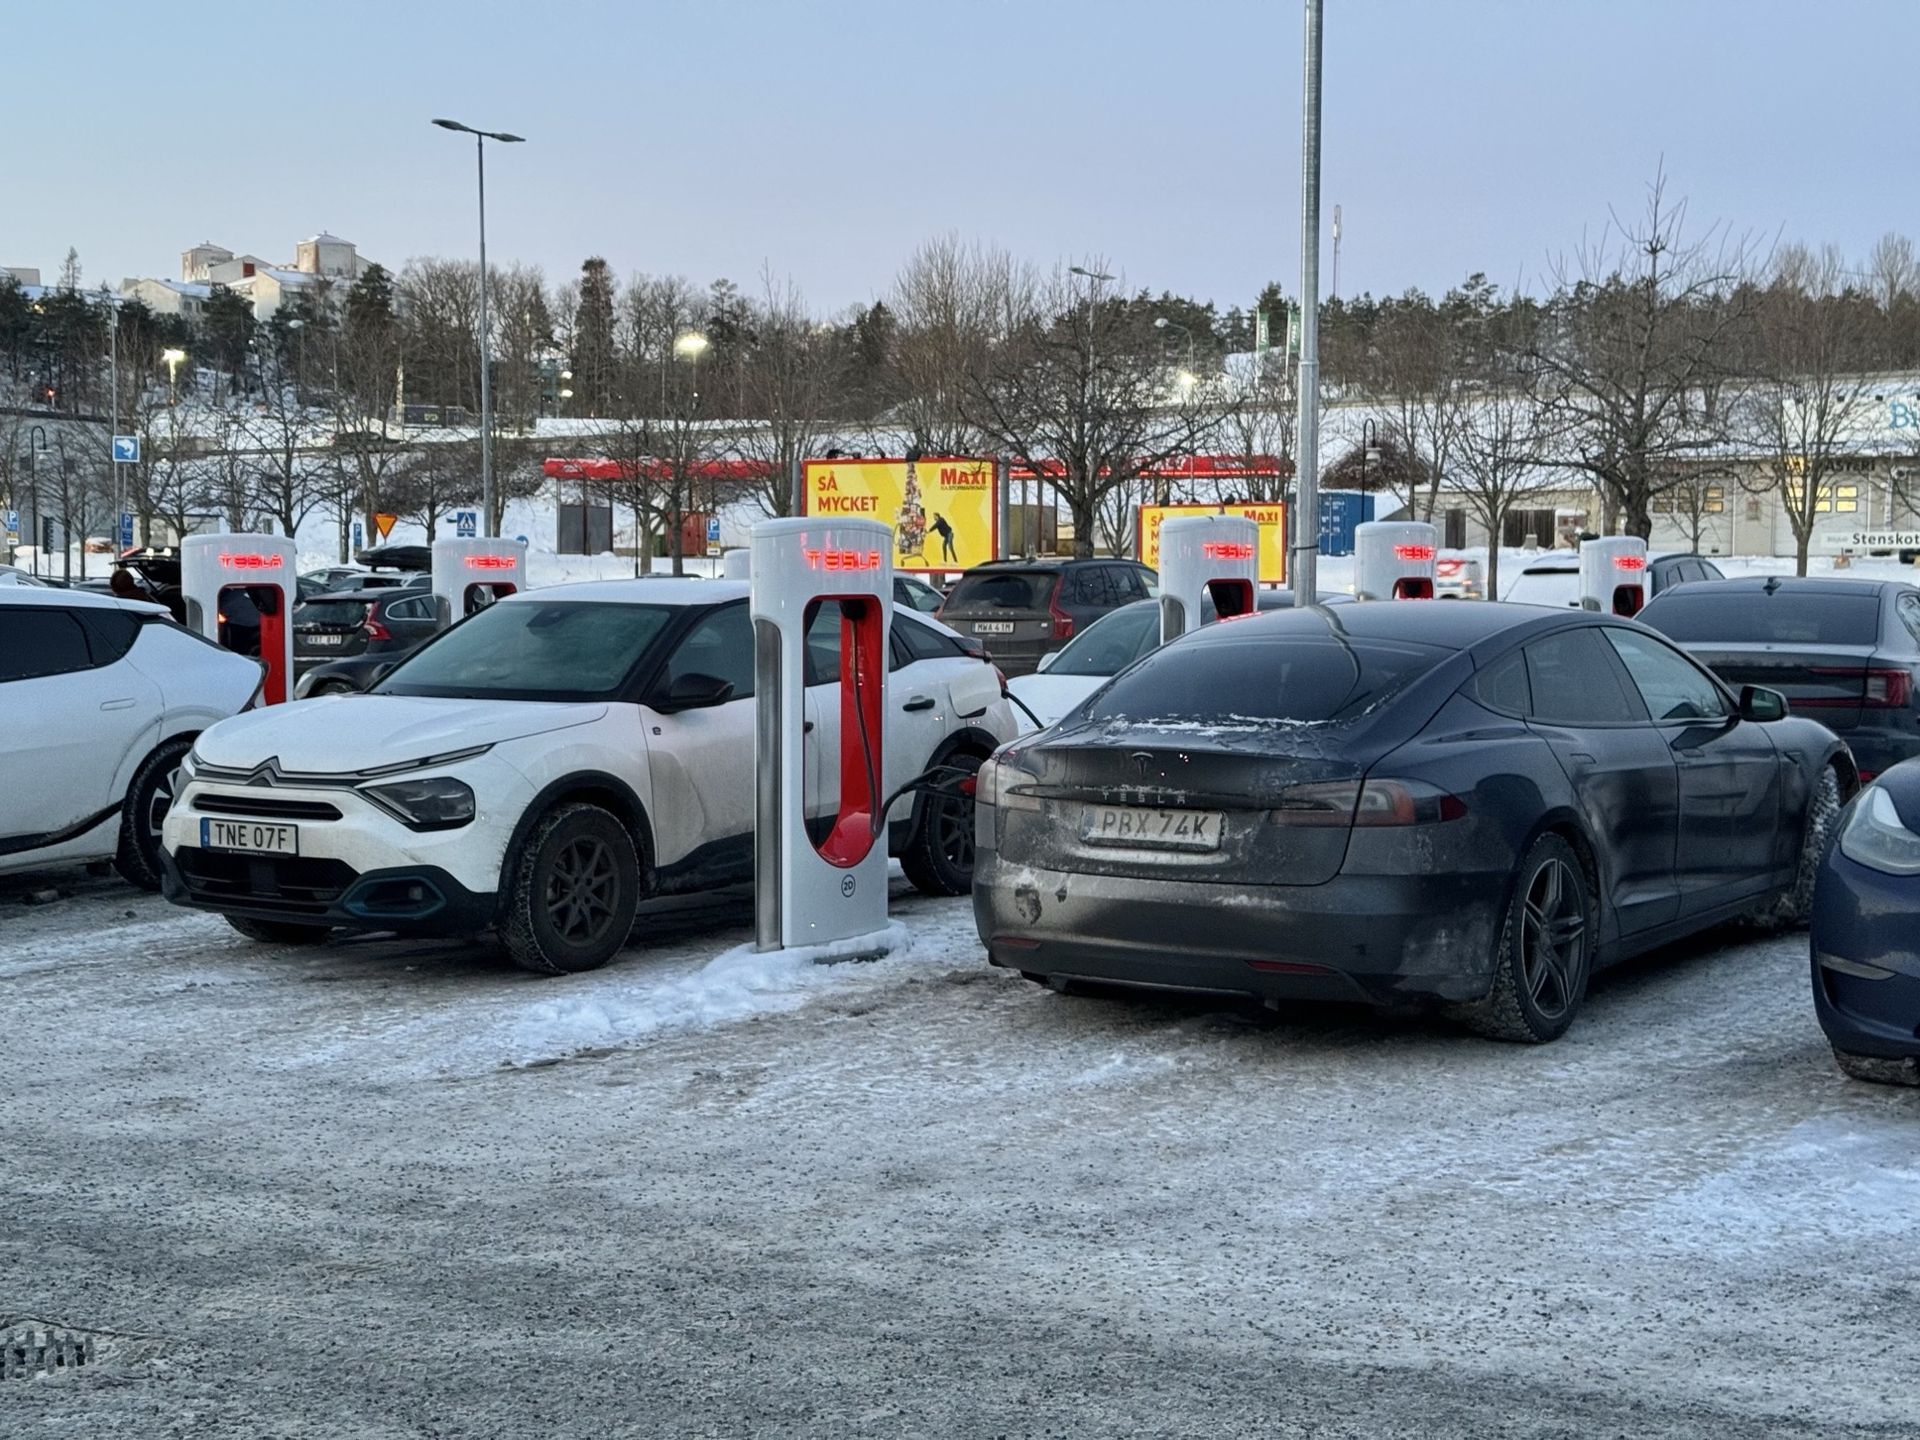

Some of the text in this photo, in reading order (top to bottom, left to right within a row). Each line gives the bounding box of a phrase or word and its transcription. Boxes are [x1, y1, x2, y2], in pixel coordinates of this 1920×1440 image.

[817, 471, 838, 491] SÅ
[940, 468, 987, 485] MAXI
[817, 496, 879, 512] MYCKET
[1243, 510, 1279, 522] MAXI
[218, 552, 283, 569] TESLA
[464, 555, 517, 569] TESLA
[807, 550, 881, 571] TESLA
[1102, 791, 1186, 804] TESLA
[1159, 811, 1209, 840] 74K
[215, 823, 287, 850] TNE 07F
